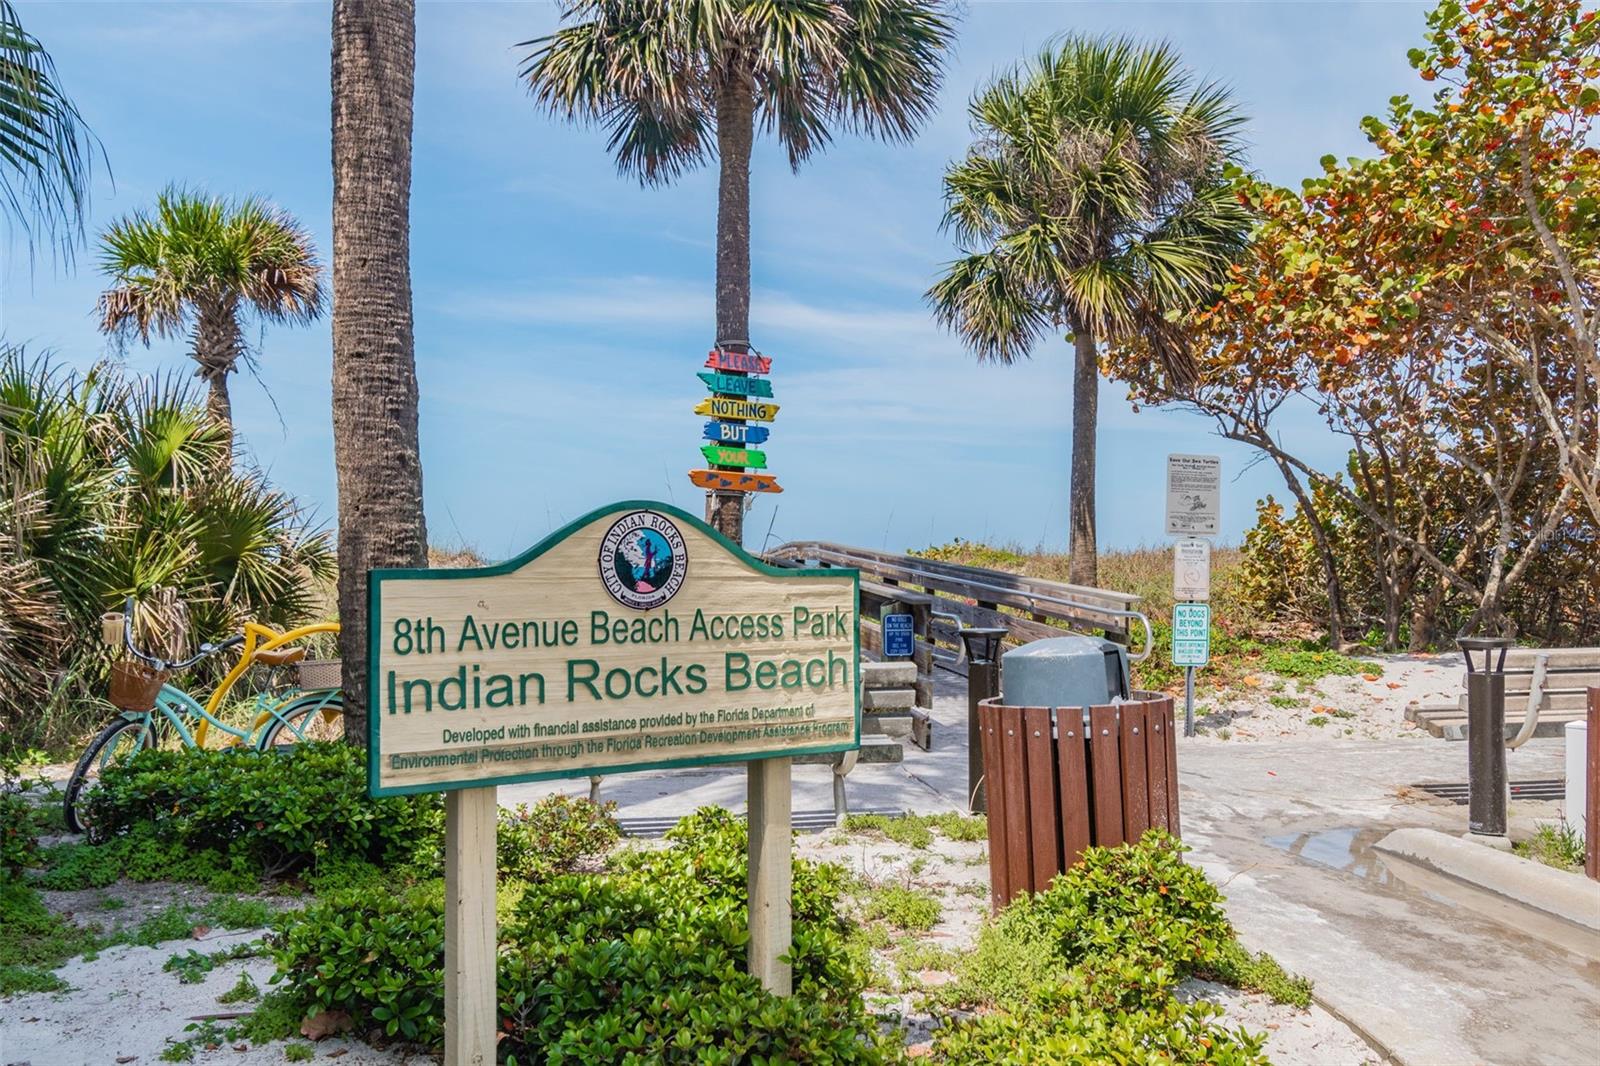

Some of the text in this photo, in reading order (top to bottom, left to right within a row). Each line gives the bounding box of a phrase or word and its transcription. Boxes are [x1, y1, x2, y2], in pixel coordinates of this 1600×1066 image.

[719, 353, 763, 372] PLEASE
[717, 376, 756, 394] LEAVE
[711, 400, 767, 419] NOTHING
[720, 424, 749, 440] BUT
[717, 449, 750, 464] YOUR
[602, 514, 685, 595] CITY OF INDIAN ROCKS BEACH
[1177, 610, 1205, 619] NO DOGS
[1179, 619, 1203, 628] BEYOND
[393, 605, 848, 656] 8th Avenue Beach Access Park
[1177, 628, 1206, 637] THIS POINT
[388, 650, 848, 714] Indian Rocks Beach
[443, 704, 814, 744] Developed with financial assistance provided by the Florida Department of
[391, 720, 849, 769] Environmental Protection through the Florida Recreation Development Assistance Program
